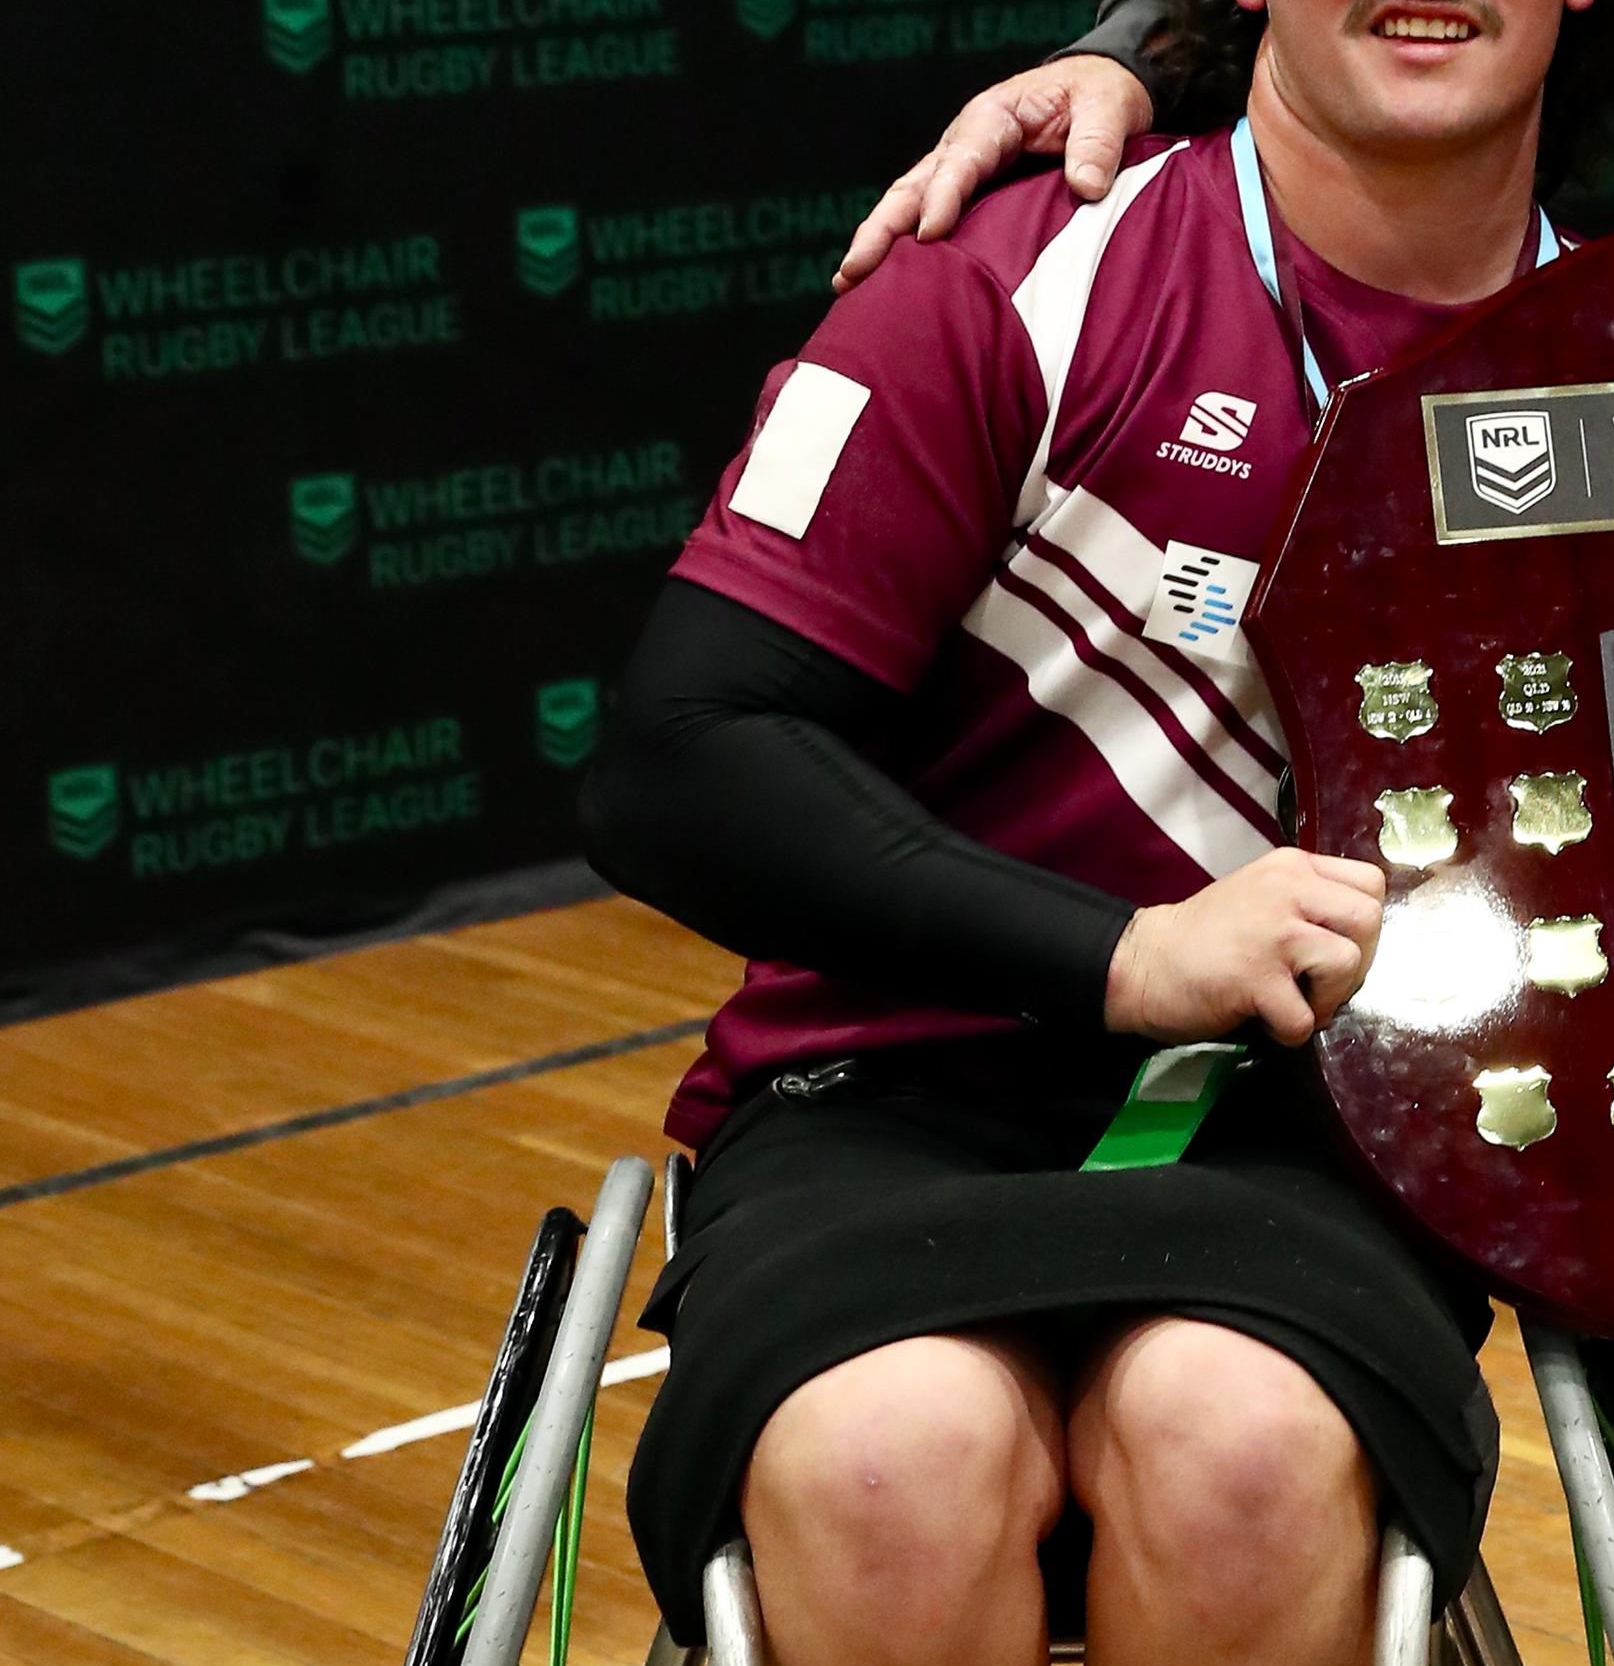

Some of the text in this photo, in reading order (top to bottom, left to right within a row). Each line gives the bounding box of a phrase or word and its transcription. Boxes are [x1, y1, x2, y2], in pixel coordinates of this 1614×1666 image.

[343, 28, 680, 101] RUGBY LEAGUE
[805, 11, 936, 65] RUGBY
[97, 234, 442, 320] WHEELCHAIR
[589, 260, 731, 322] RUGBY
[102, 296, 462, 381] RUGBY LEAGUE
[1156, 441, 1252, 480] STRUDDYS
[1480, 424, 1541, 451] NRL
[366, 440, 684, 529] WHEELCHAIR
[369, 525, 519, 589] RUGBY
[130, 716, 463, 819] WHEELCHAIR
[132, 770, 484, 879] RUGBY LEAGUE
